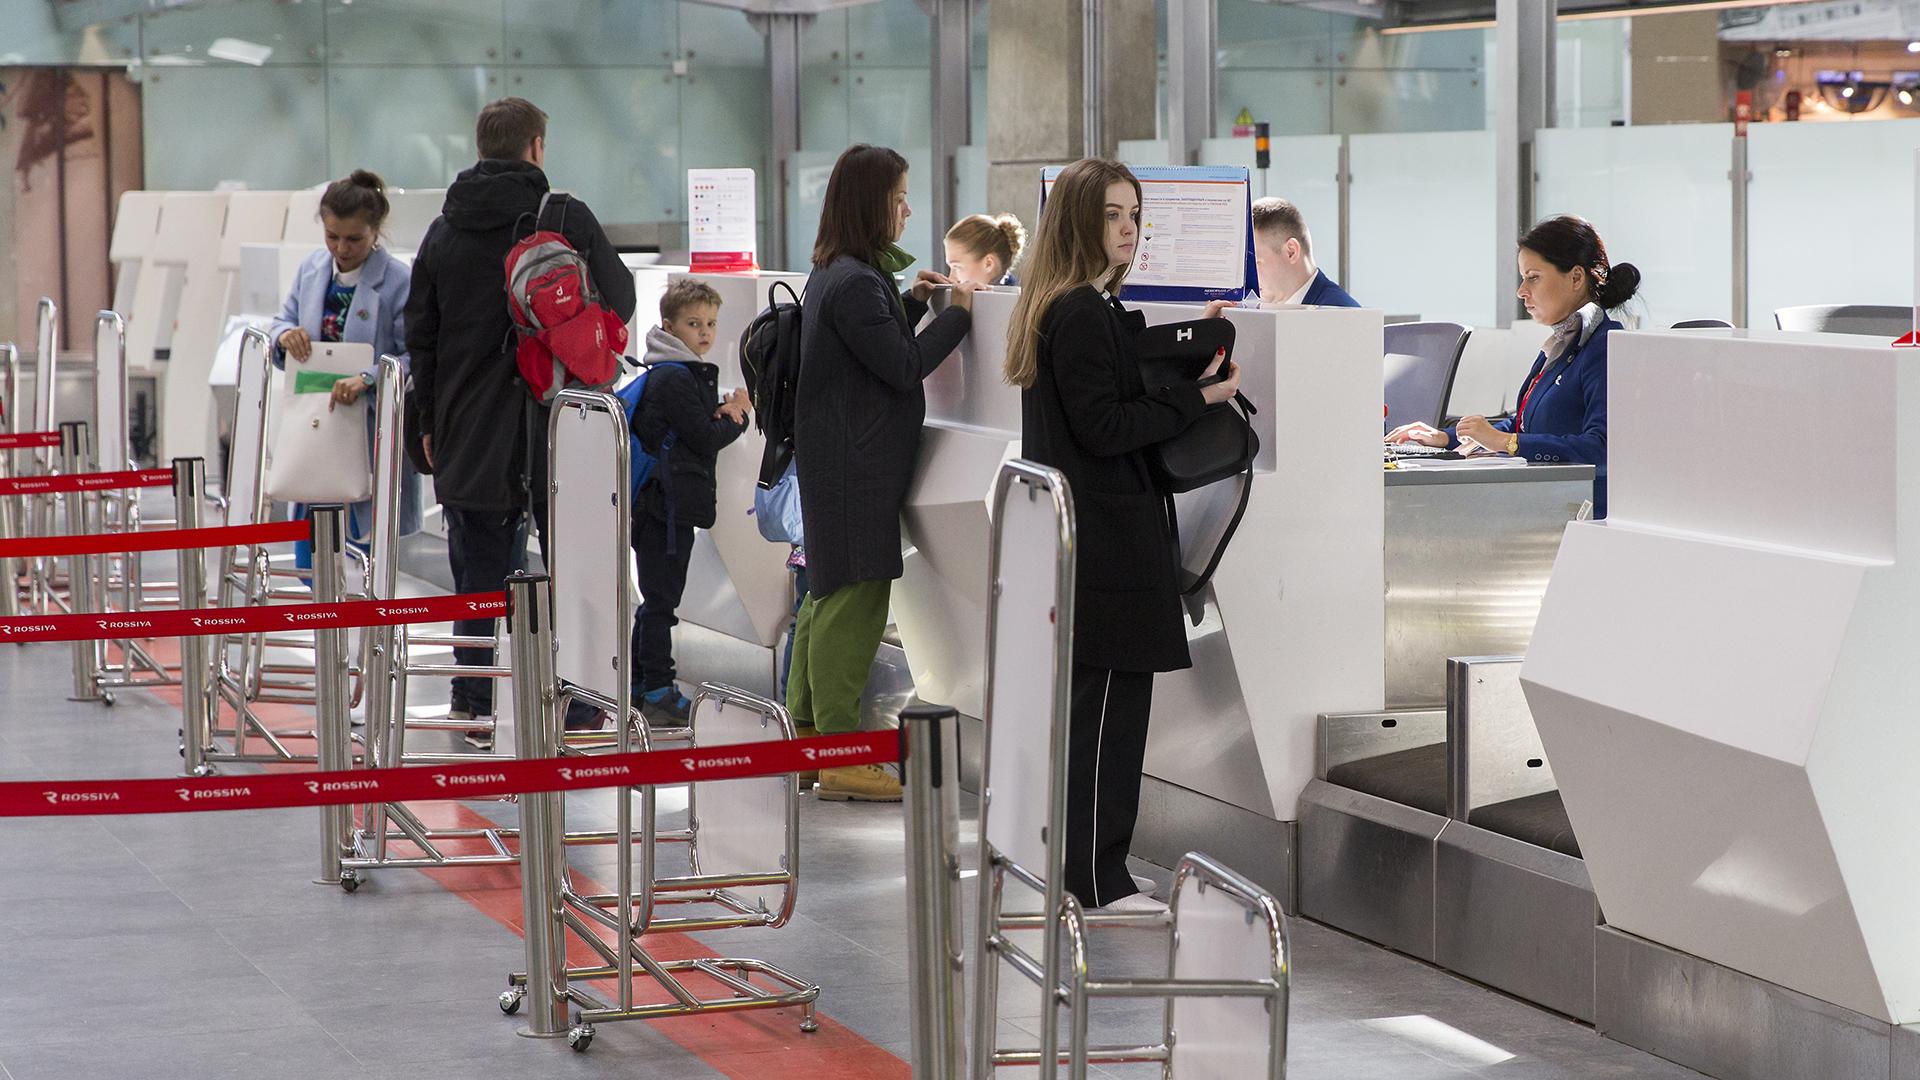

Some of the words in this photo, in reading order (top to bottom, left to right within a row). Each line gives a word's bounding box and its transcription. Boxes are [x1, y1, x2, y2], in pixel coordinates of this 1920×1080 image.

[296, 612, 338, 621] ROSSIYA
[388, 607, 429, 615] ROSSIYA
[109, 620, 152, 628] ROSSIYA
[204, 617, 246, 626] ROSSIYA
[13, 624, 57, 633] ROSSIYA
[818, 744, 872, 758] ROSSIYA
[696, 756, 752, 769] ROSSIYA
[574, 765, 630, 778] ROSSIYA
[449, 773, 506, 785] ROSSIYA
[322, 779, 379, 792] ROSSIYA
[61, 791, 120, 802] ROSSIYA
[193, 787, 251, 799] ROSSIYA
